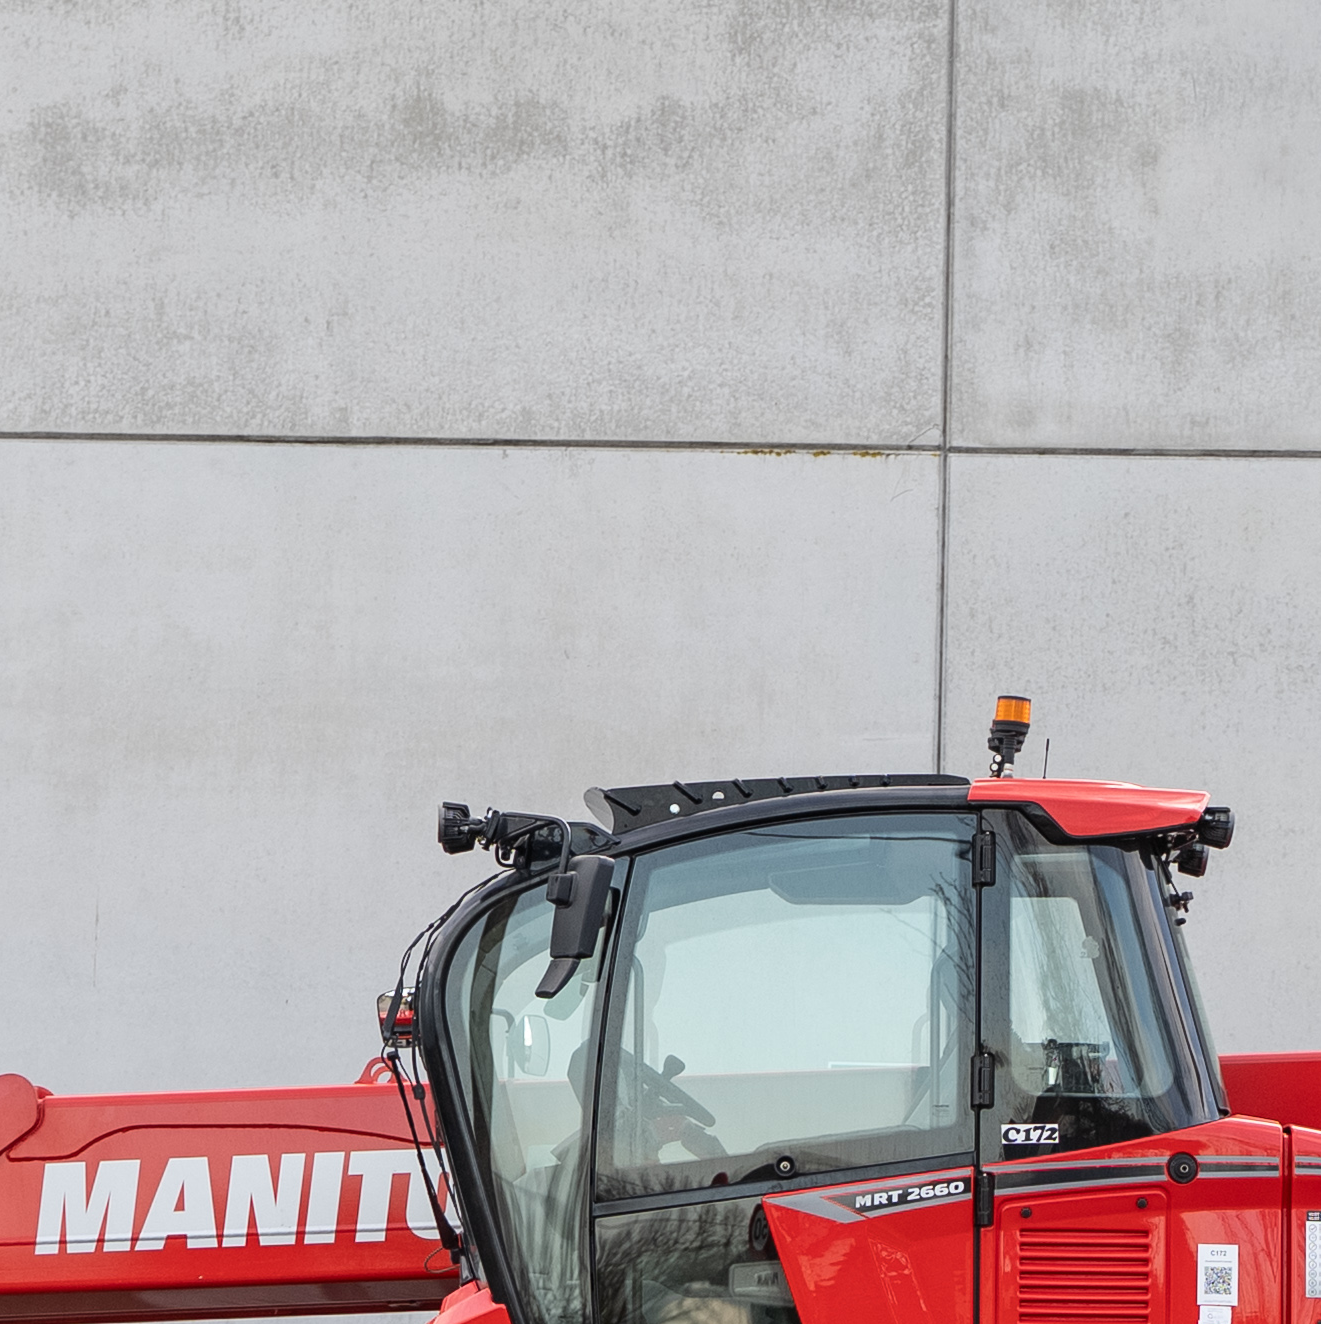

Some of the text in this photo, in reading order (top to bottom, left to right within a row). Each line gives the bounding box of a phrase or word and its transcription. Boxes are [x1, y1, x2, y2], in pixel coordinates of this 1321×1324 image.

[1002, 1125, 1059, 1143] C172
[855, 1181, 965, 1209] MRT 2660
